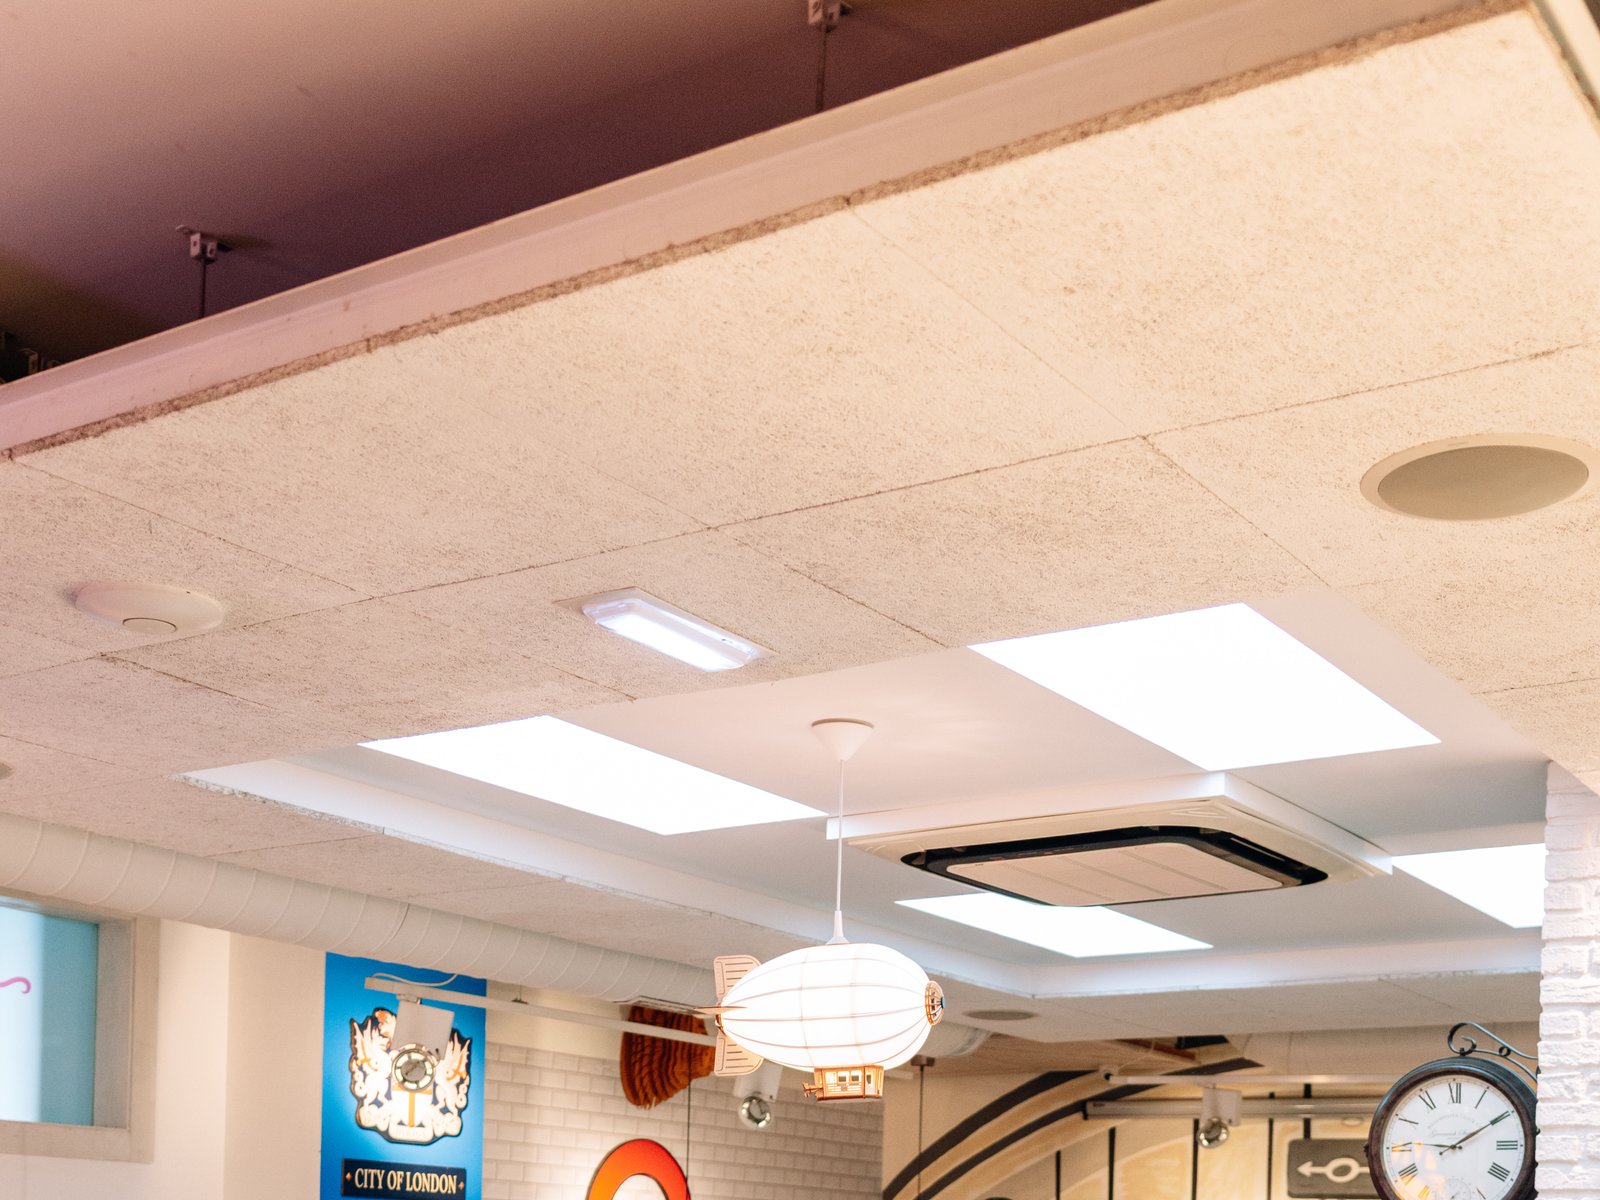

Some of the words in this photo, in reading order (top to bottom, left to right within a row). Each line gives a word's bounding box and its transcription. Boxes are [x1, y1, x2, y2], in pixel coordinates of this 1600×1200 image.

[354, 1167, 385, 1189] CITY
[386, 1169, 404, 1190] OF
[405, 1171, 457, 1195] LONDON
